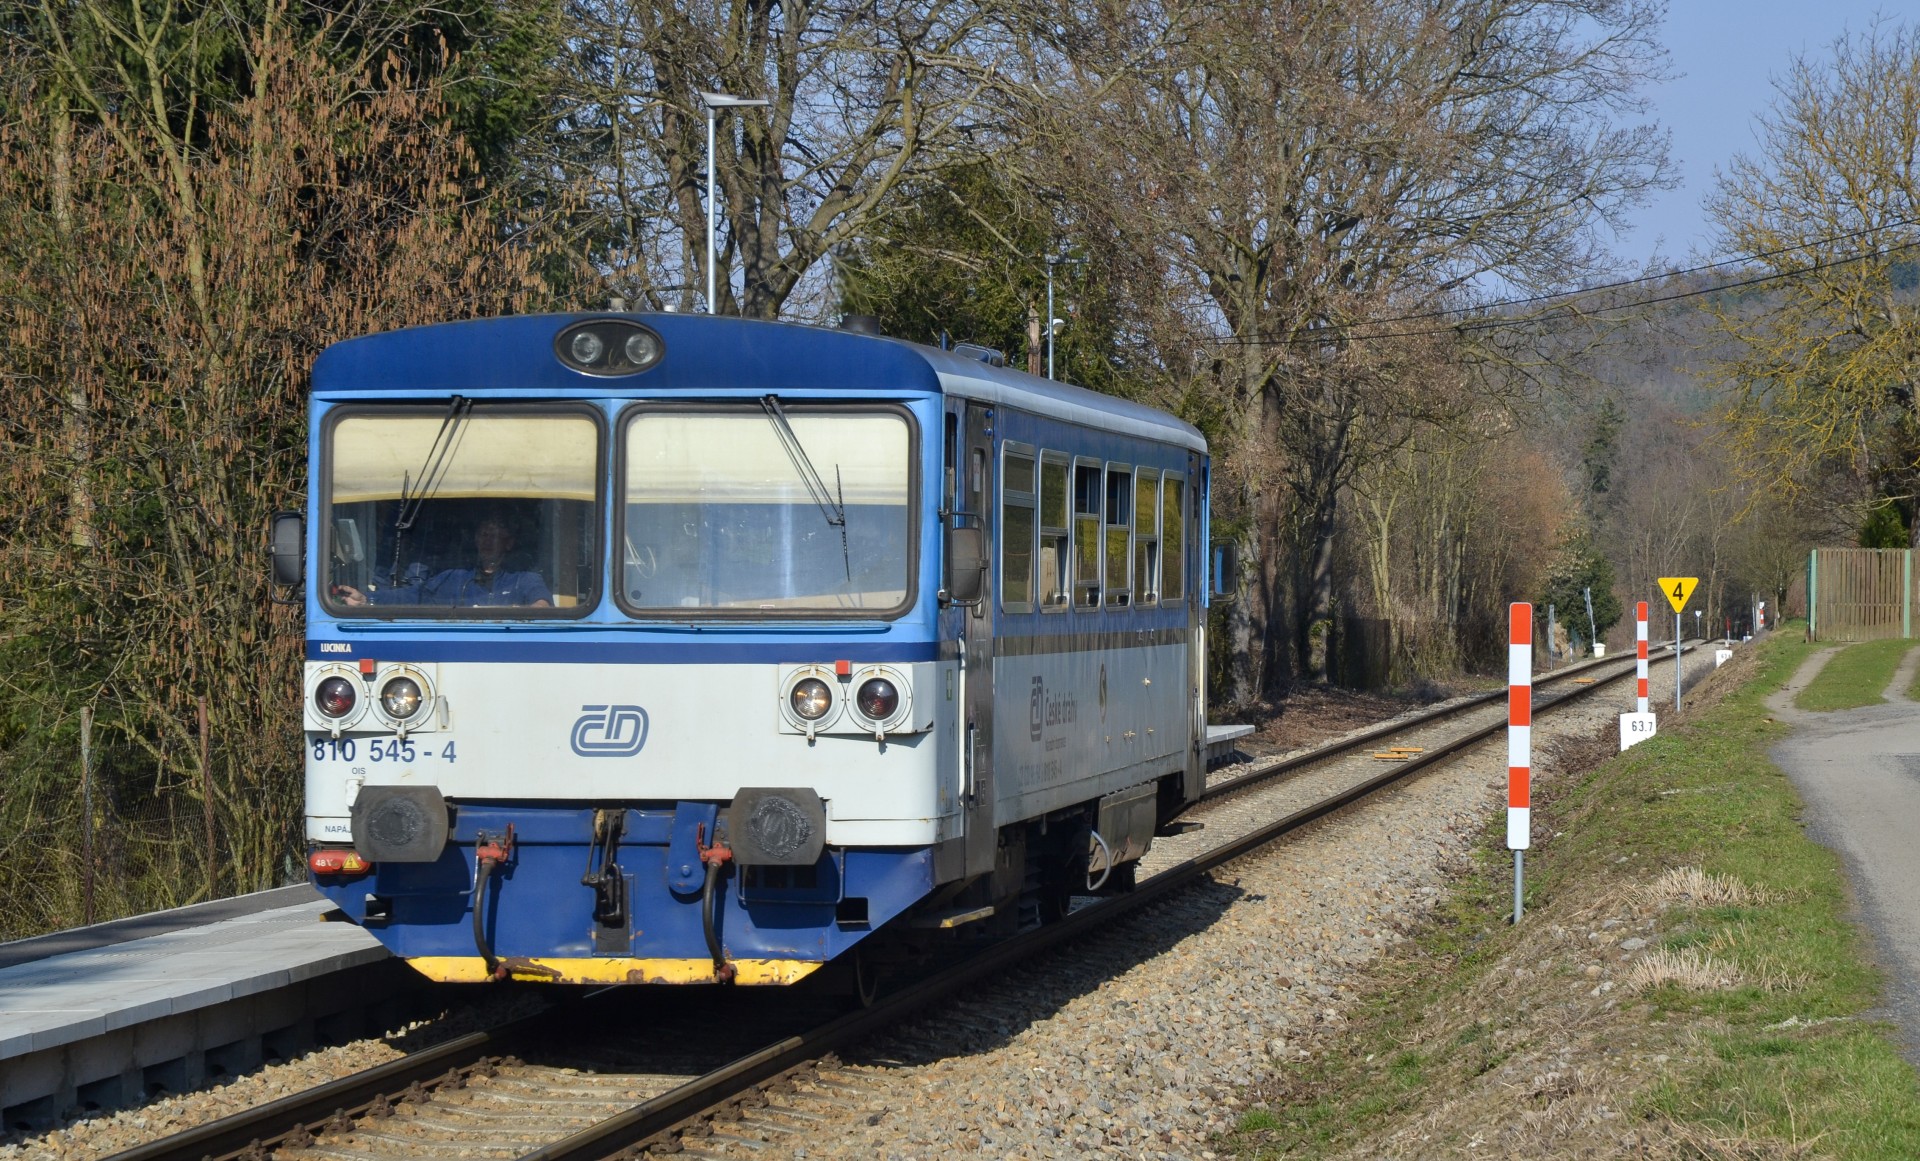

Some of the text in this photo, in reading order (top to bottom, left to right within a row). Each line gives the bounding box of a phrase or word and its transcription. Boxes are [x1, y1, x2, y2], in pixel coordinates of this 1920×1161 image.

[1672, 581, 1684, 601] 4
[320, 643, 352, 653] LUCINKA
[1631, 720, 1653, 732] 63.7
[313, 738, 356, 762] 810
[351, 767, 366, 775] OIS
